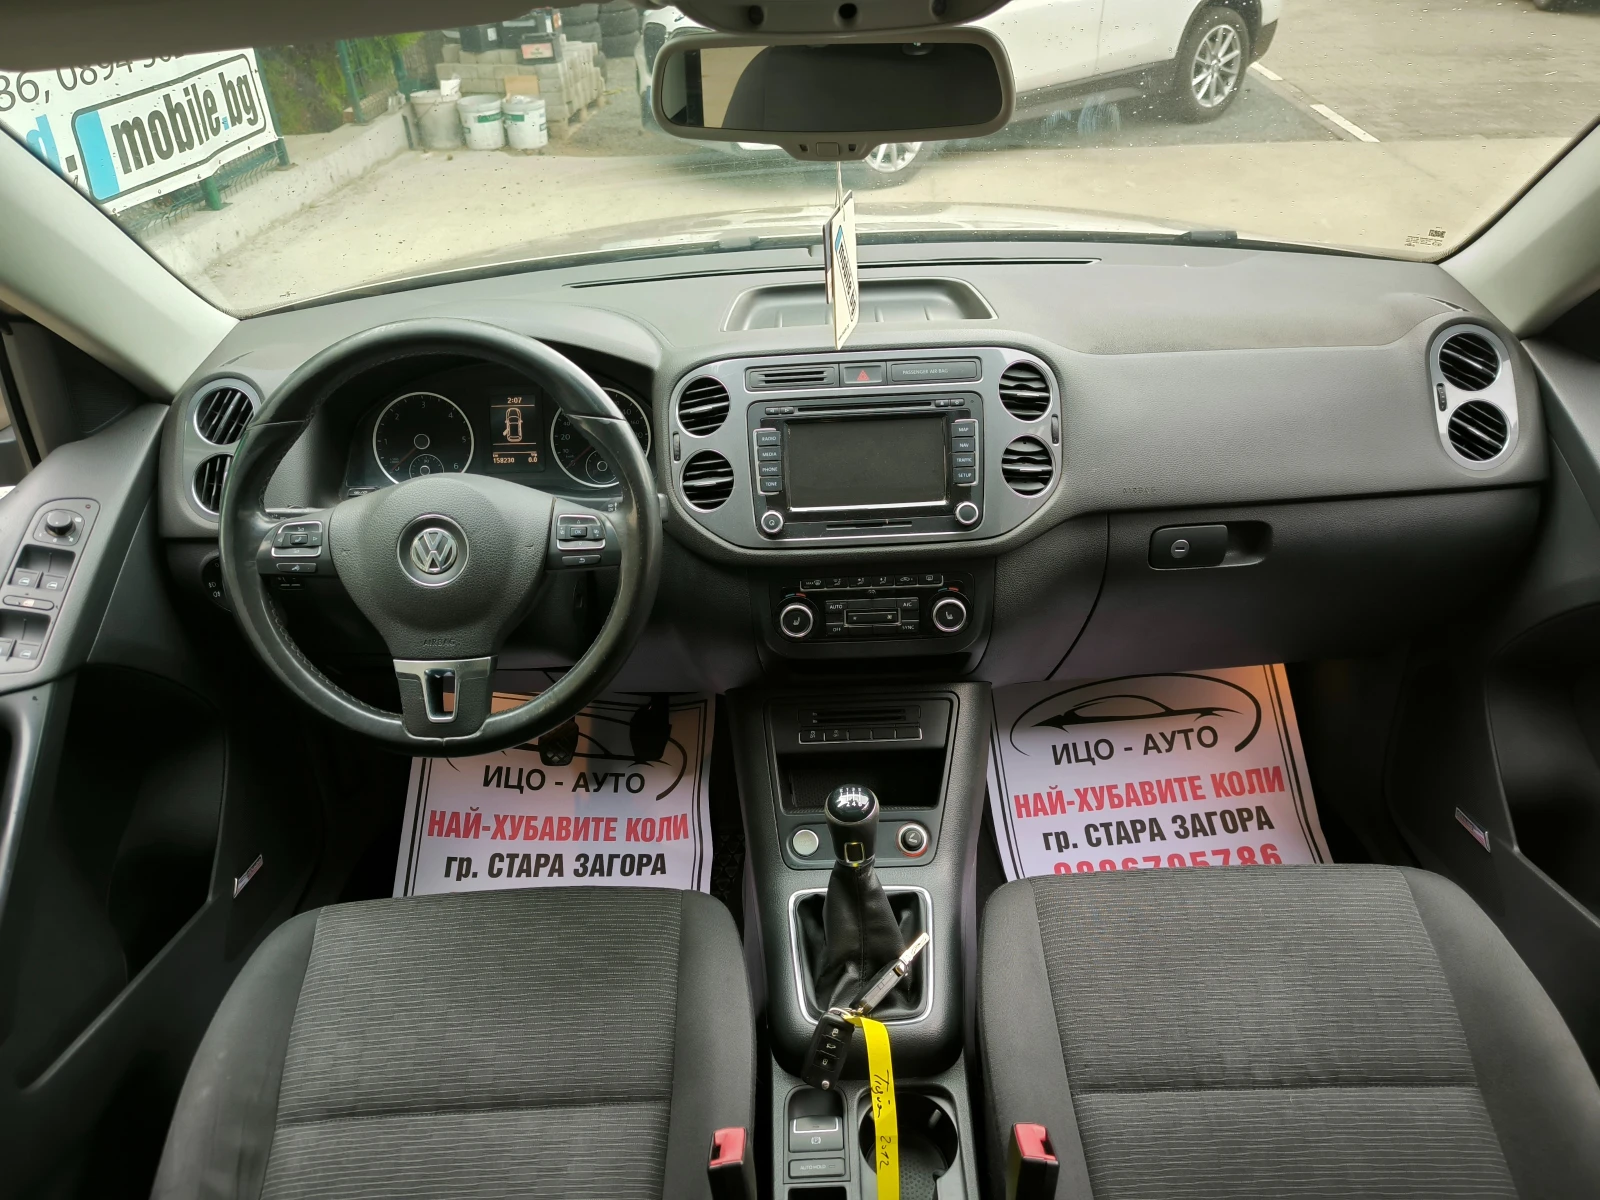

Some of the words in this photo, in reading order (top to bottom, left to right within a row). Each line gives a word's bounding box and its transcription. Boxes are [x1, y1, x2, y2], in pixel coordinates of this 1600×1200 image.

[110, 71, 259, 175] mobile.bg
[561, 433, 571, 441] 20
[453, 462, 459, 470] 6
[1051, 738, 1115, 767] ИЦО
[1142, 725, 1219, 756] АУТО
[482, 765, 546, 794] ИЦО
[571, 772, 646, 794] АУТО
[1013, 775, 1207, 819] НАЙ-ХУБАВИТЕ
[1210, 765, 1285, 799] КОЛИ
[427, 806, 618, 842] НАЙ-ХУБАВИТЕ
[625, 813, 689, 842] КОЛИ
[1042, 830, 1078, 853] гр.
[1084, 815, 1166, 848] СТАРА
[1171, 805, 1275, 840] ЗАГОРА
[444, 856, 478, 881] гр.
[487, 852, 564, 879] СТАРА
[573, 853, 667, 878] ЗАГОРА
